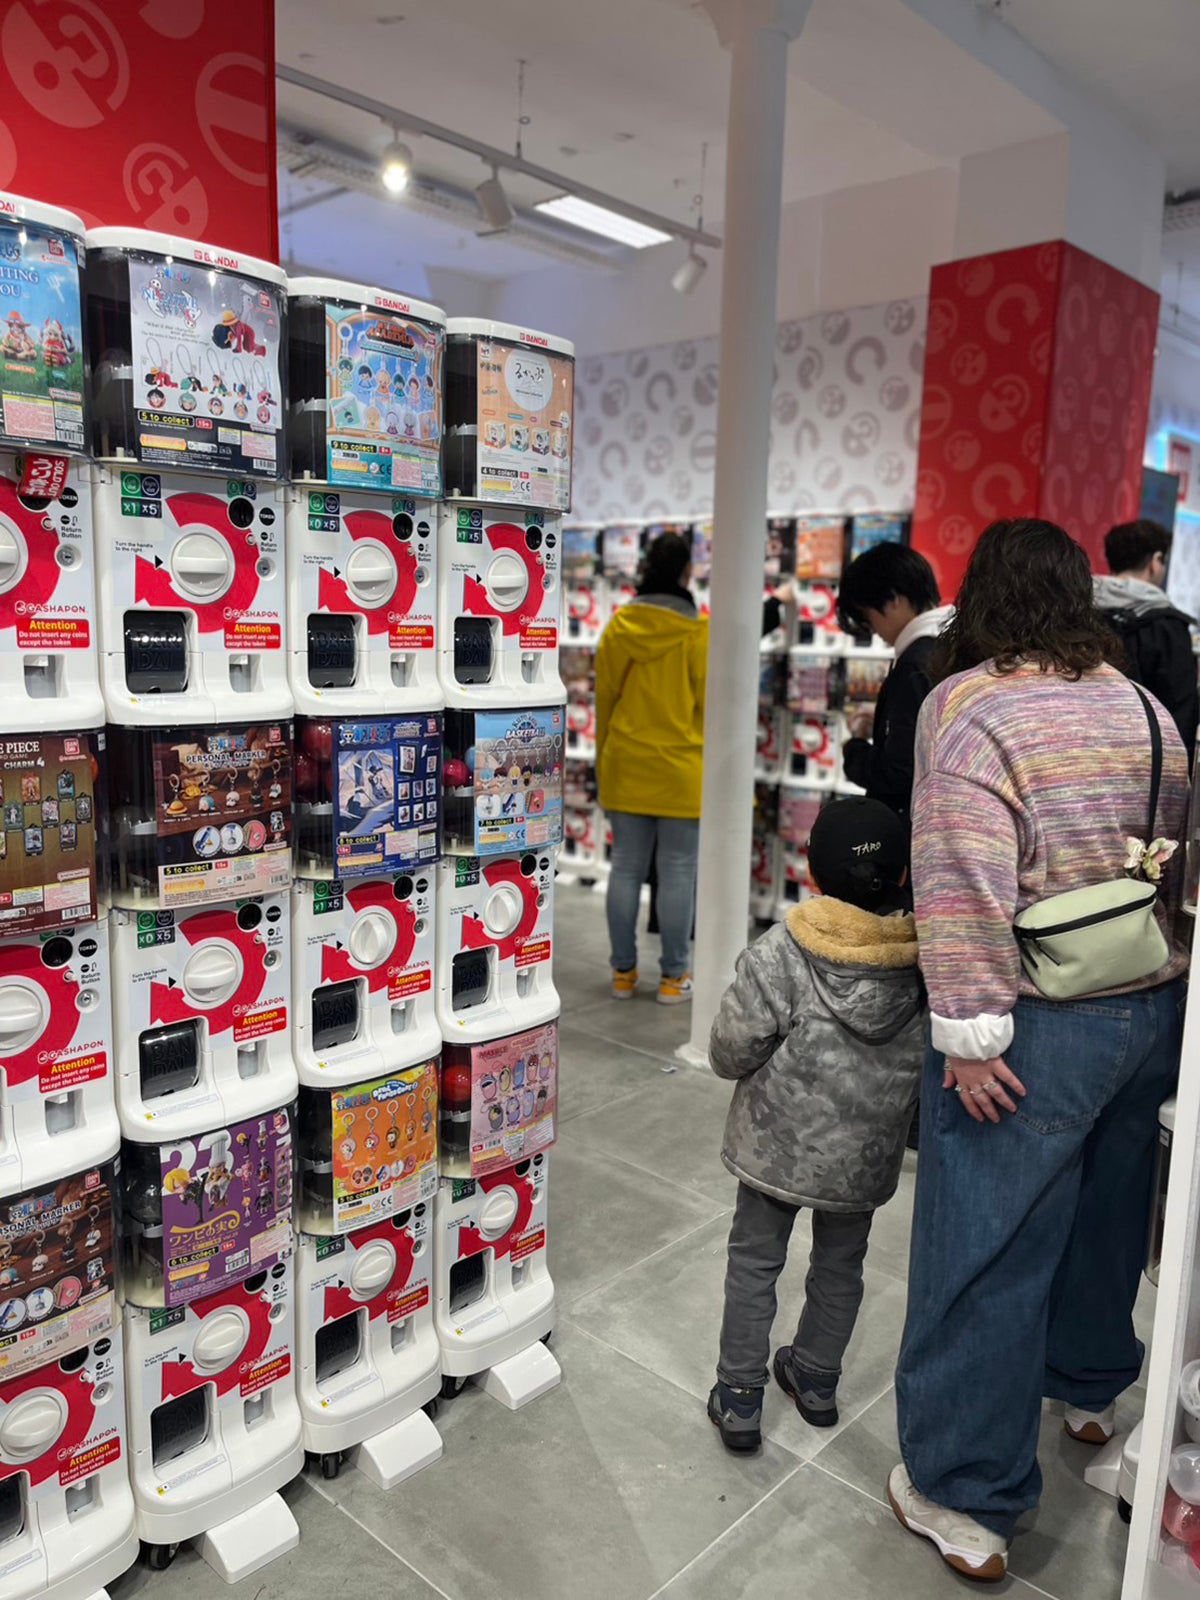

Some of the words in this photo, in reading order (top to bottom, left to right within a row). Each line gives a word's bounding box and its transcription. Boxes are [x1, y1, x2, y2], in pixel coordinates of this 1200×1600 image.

[382, 298, 410, 313] BANDAI
[526, 334, 549, 347] BANDAI
[141, 410, 148, 418] 5
[150, 413, 160, 421] to
[163, 415, 190, 426] collect
[340, 442, 349, 450] to
[351, 444, 375, 453] collect
[52, 460, 65, 482] SOLD
[497, 469, 517, 478] collect
[27, 603, 86, 613] GASHAPON
[233, 609, 278, 618] GASHAPON
[29, 620, 77, 630] Attention
[234, 623, 271, 633] Attention
[397, 626, 427, 635] Attention
[6, 741, 40, 754] PIECE
[4, 760, 35, 769] CHARM
[36, 757, 45, 767] 4
[186, 753, 232, 763] PERSONAL
[234, 750, 266, 760] MARKER
[851, 841, 881, 857] TARO
[166, 867, 172, 875] 5
[185, 863, 209, 872] collect
[396, 973, 425, 986] Attention
[241, 996, 285, 1013] GASHAPON
[242, 1011, 278, 1026] Attention
[49, 1040, 104, 1059] GASHAPON
[51, 1056, 95, 1074] Attention
[62, 1070, 78, 1078] insert
[41, 1083, 61, 1091] except
[73, 1074, 90, 1083] token
[41, 1200, 82, 1221] MARKER
[169, 1220, 228, 1248] ワンピの実
[190, 1248, 217, 1261] collect
[249, 1359, 282, 1380] Attention
[66, 1426, 118, 1454] GASHAPON
[70, 1443, 110, 1467] Attention
